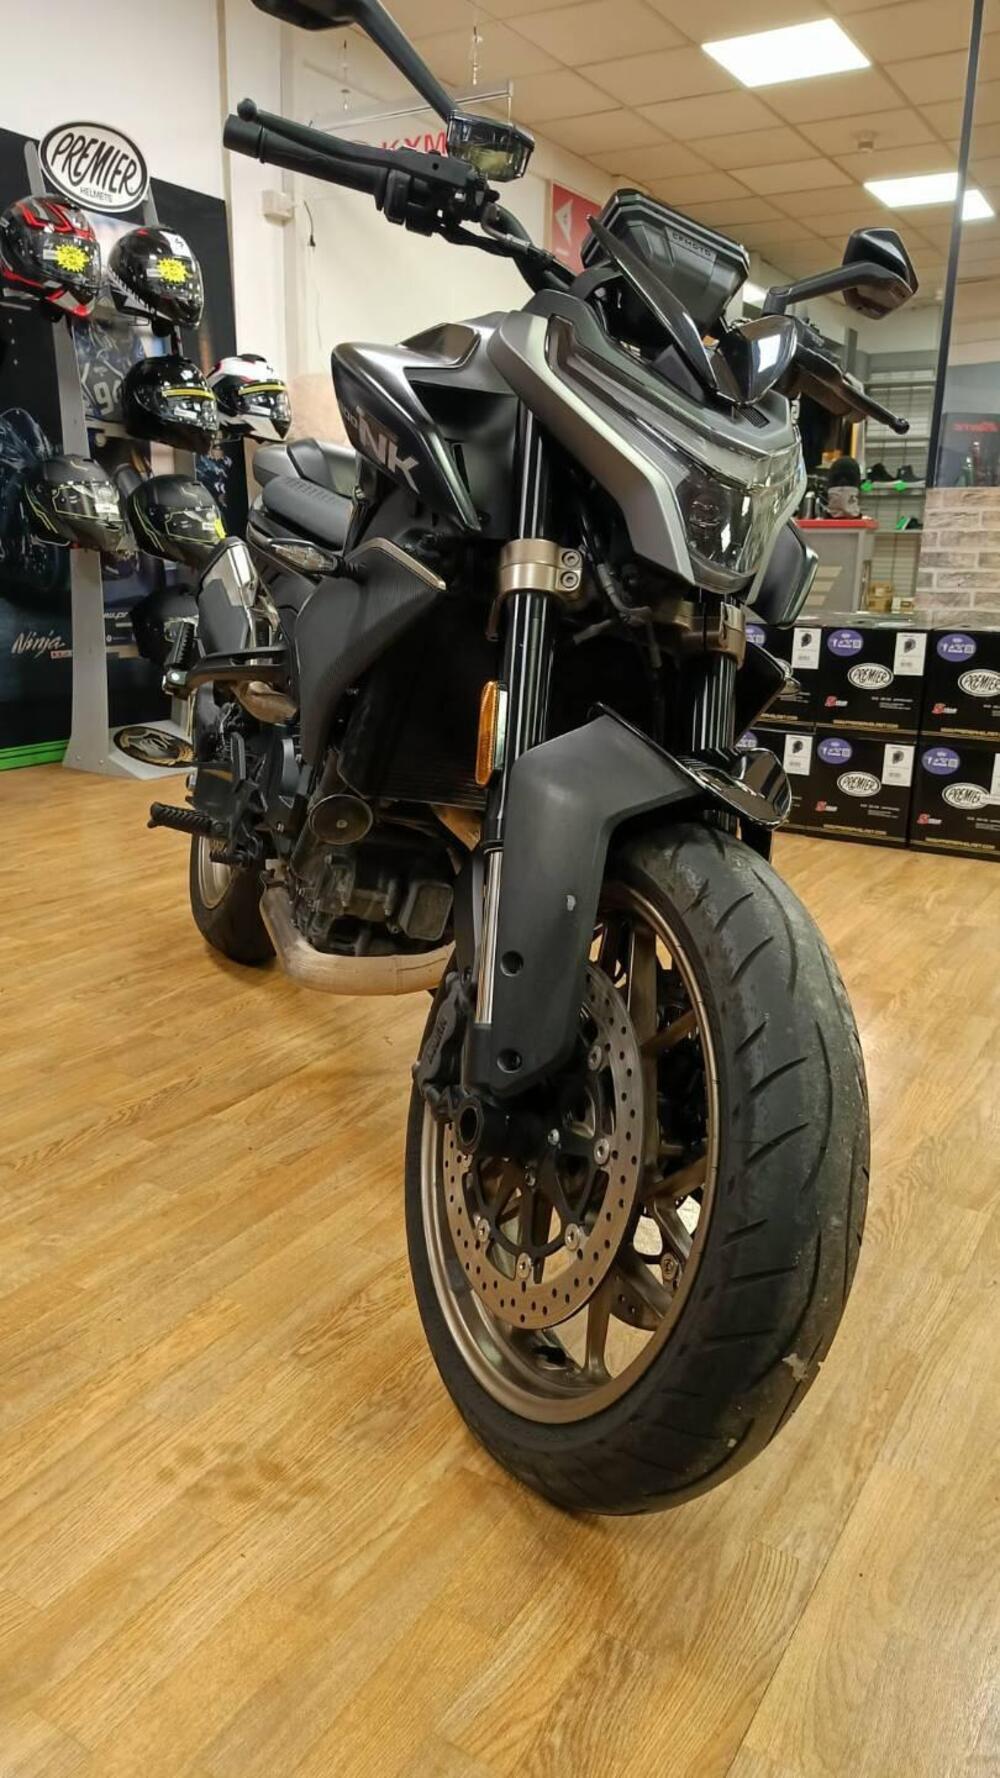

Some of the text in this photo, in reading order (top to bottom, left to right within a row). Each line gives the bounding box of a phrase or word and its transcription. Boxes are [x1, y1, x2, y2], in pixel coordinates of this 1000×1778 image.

[51, 132, 141, 196] PREMIER
[80, 186, 113, 203] HELMETS
[672, 230, 711, 257] CFMOTO
[356, 406, 420, 494] NK
[11, 630, 66, 659] Ninja
[853, 668, 887, 684] PREMIER
[843, 777, 876, 792] PREMIER
